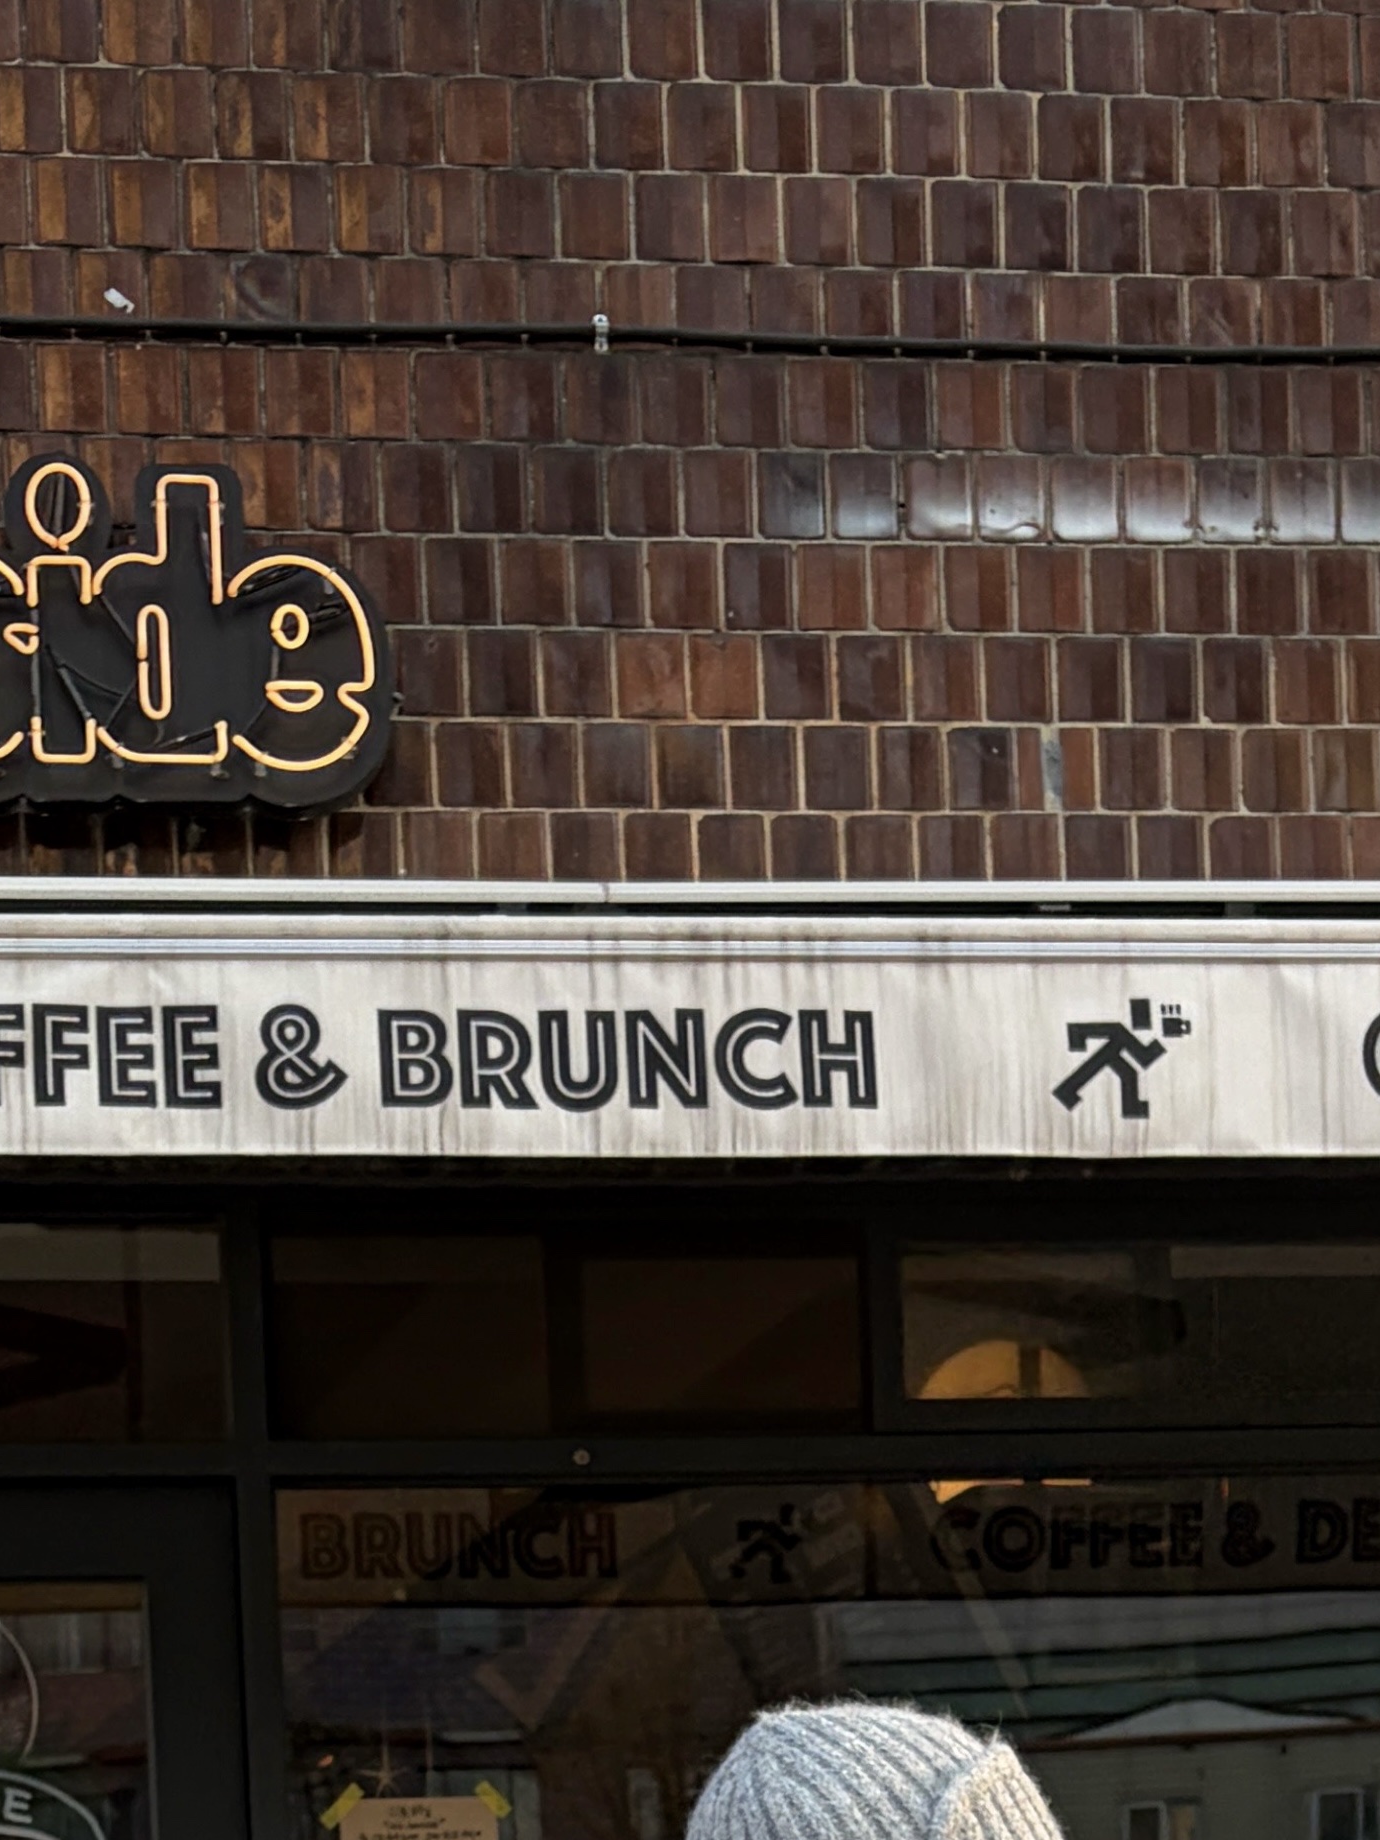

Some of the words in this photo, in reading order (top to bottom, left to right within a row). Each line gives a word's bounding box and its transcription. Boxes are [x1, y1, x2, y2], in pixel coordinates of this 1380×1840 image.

[252, 1002, 347, 1110] &
[378, 1007, 879, 1113] BRUNCH
[300, 1511, 619, 1581] BRUNCH
[932, 1505, 1204, 1572] COFFEE
[1222, 1502, 1275, 1567] &
